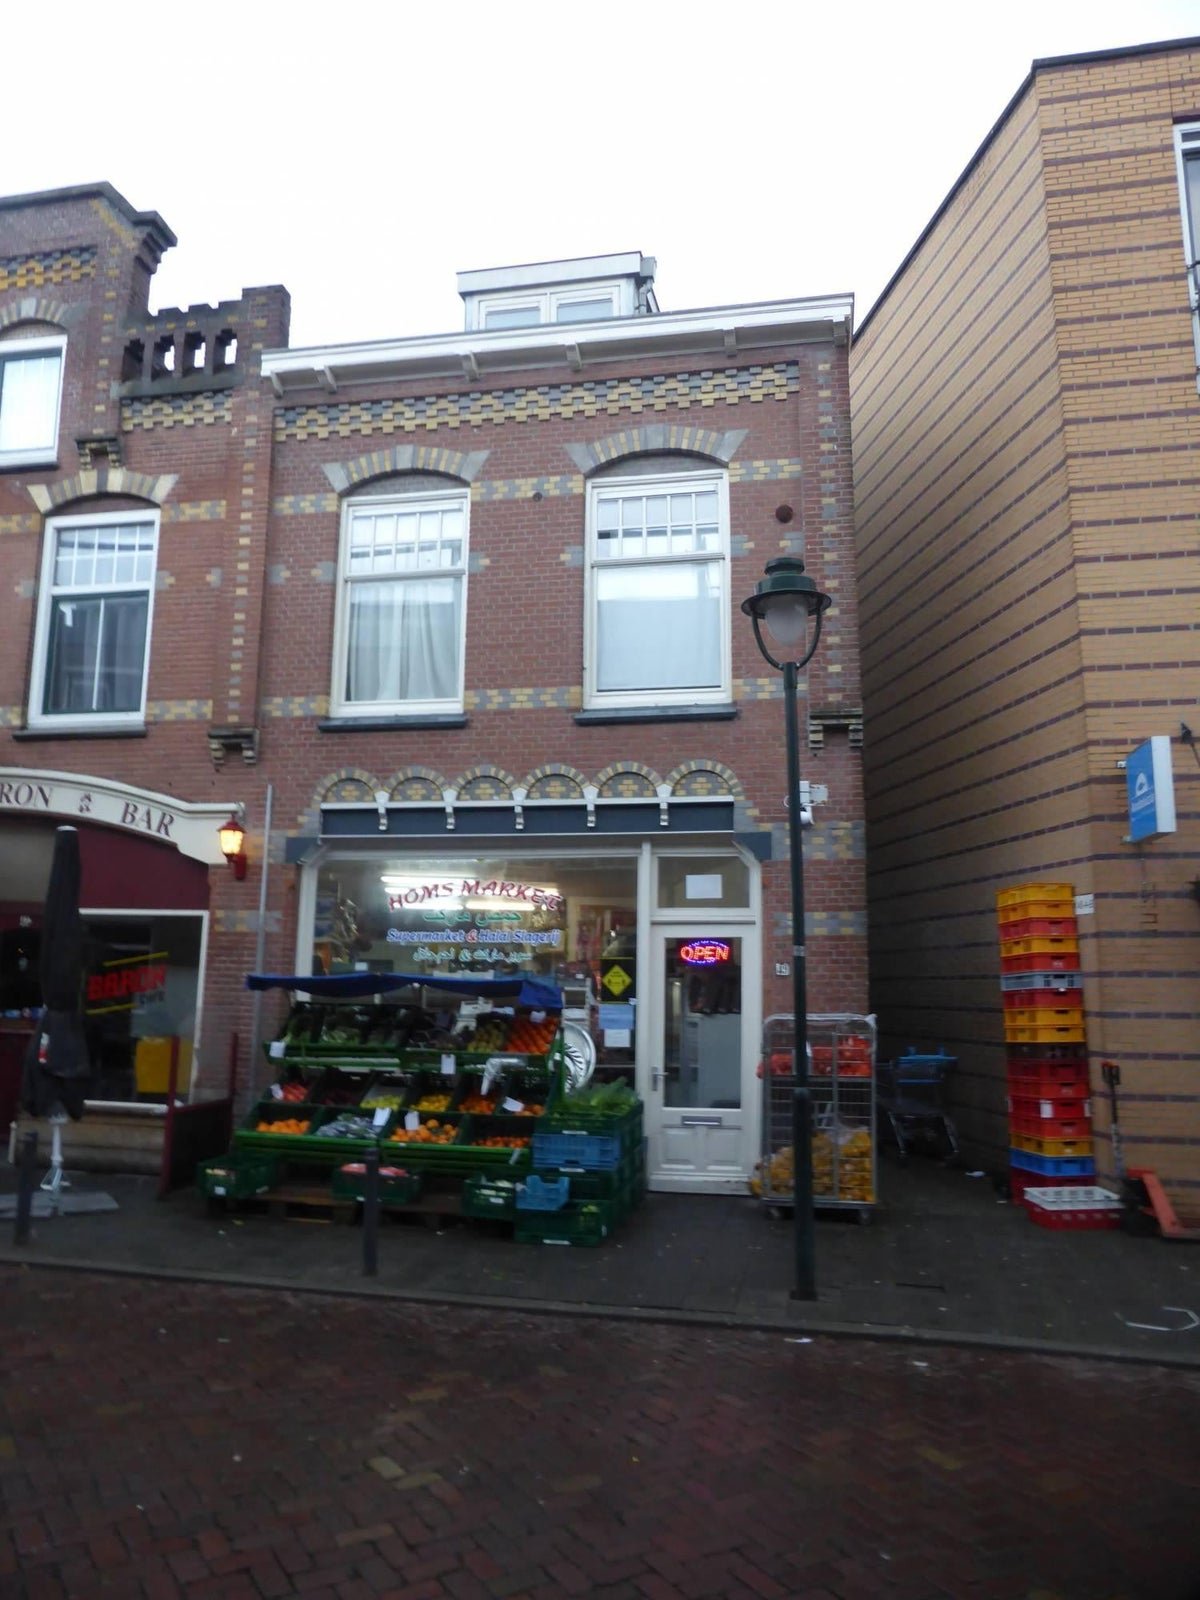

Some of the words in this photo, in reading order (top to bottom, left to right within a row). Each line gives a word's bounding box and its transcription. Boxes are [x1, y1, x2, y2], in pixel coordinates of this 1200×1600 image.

[121, 801, 174, 837] BAR
[389, 882, 454, 912] HOMS
[462, 880, 563, 911] MARKET
[387, 928, 465, 944] Supermarket
[466, 928, 478, 943] &
[479, 929, 510, 943] Halal
[513, 929, 561, 946] Slagerij
[681, 945, 729, 960] OPEN
[87, 964, 166, 1001] BARON
